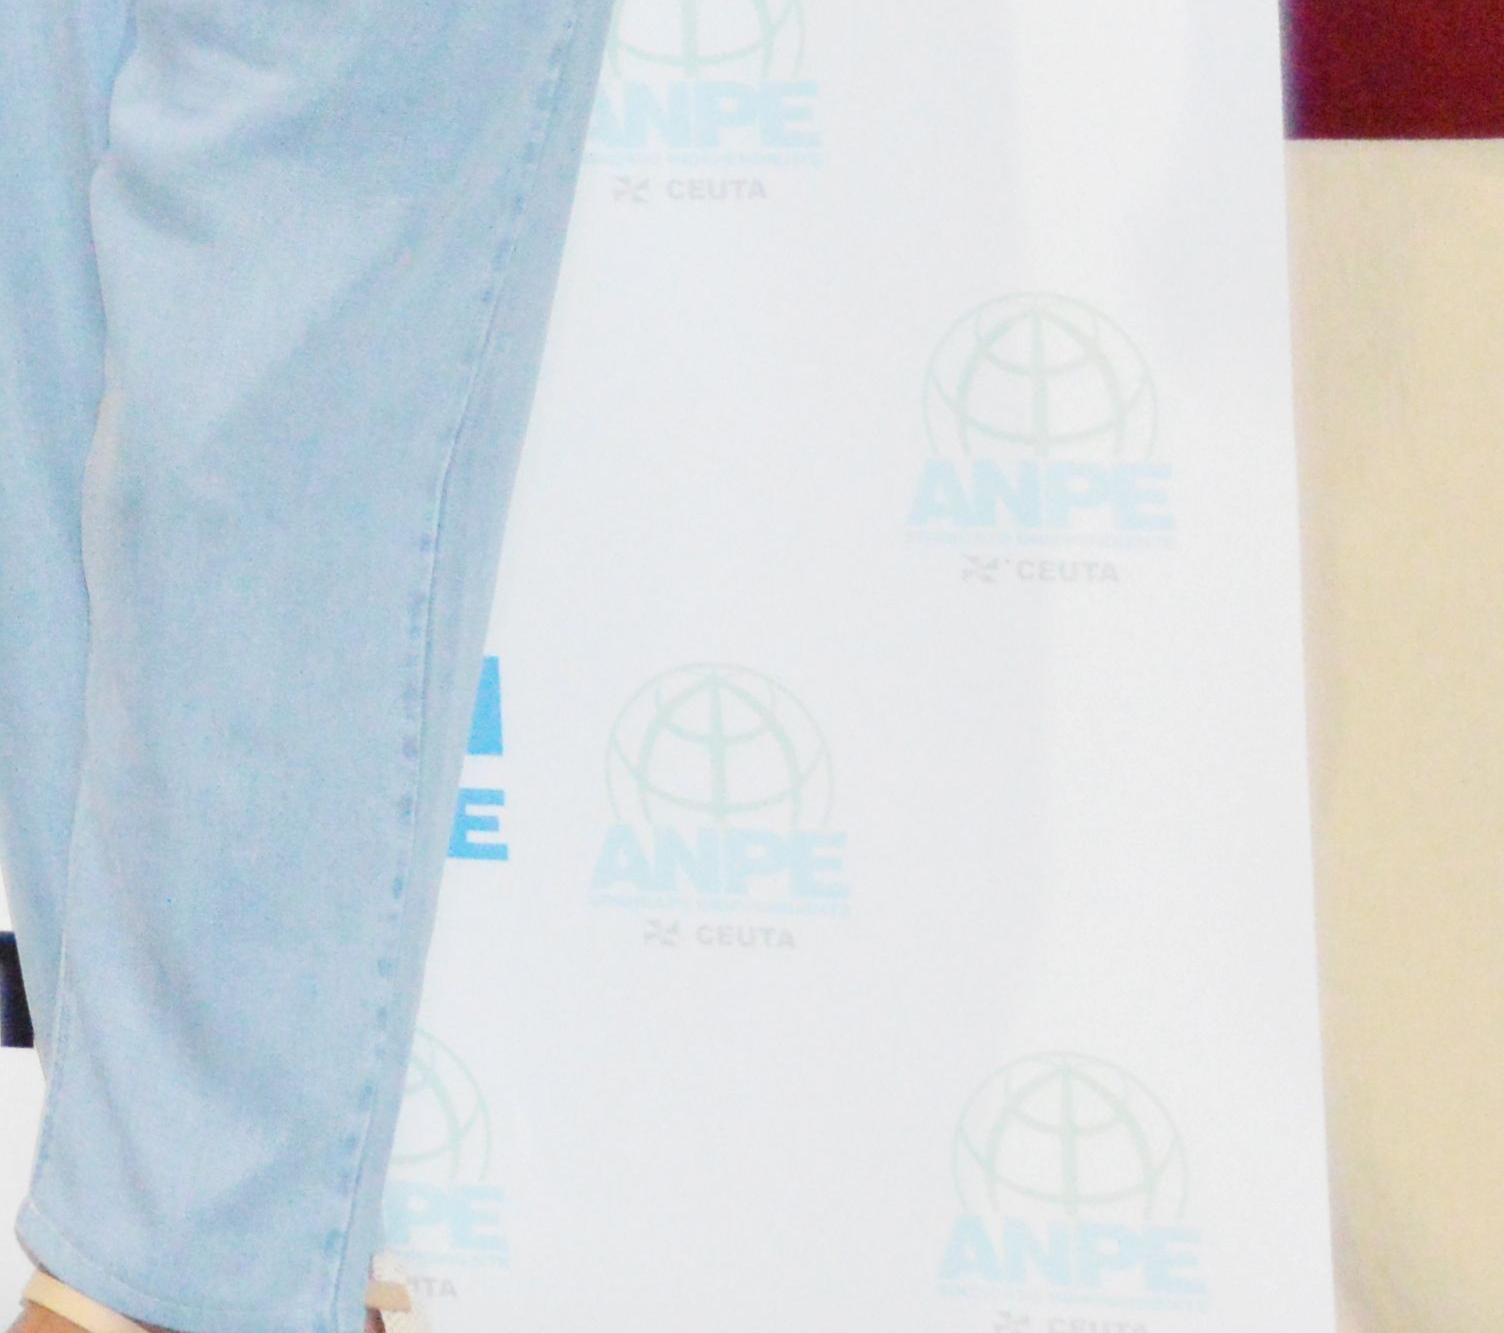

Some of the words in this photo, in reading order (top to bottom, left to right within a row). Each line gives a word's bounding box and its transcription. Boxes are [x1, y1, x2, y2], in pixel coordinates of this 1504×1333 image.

[666, 179, 767, 199] CEUTA
[907, 458, 1175, 531] ANPE
[1017, 560, 1118, 583] CEUTA
[591, 823, 851, 898] ANPE
[696, 925, 795, 949] CEUTA
[936, 1214, 1208, 1294] ANPE
